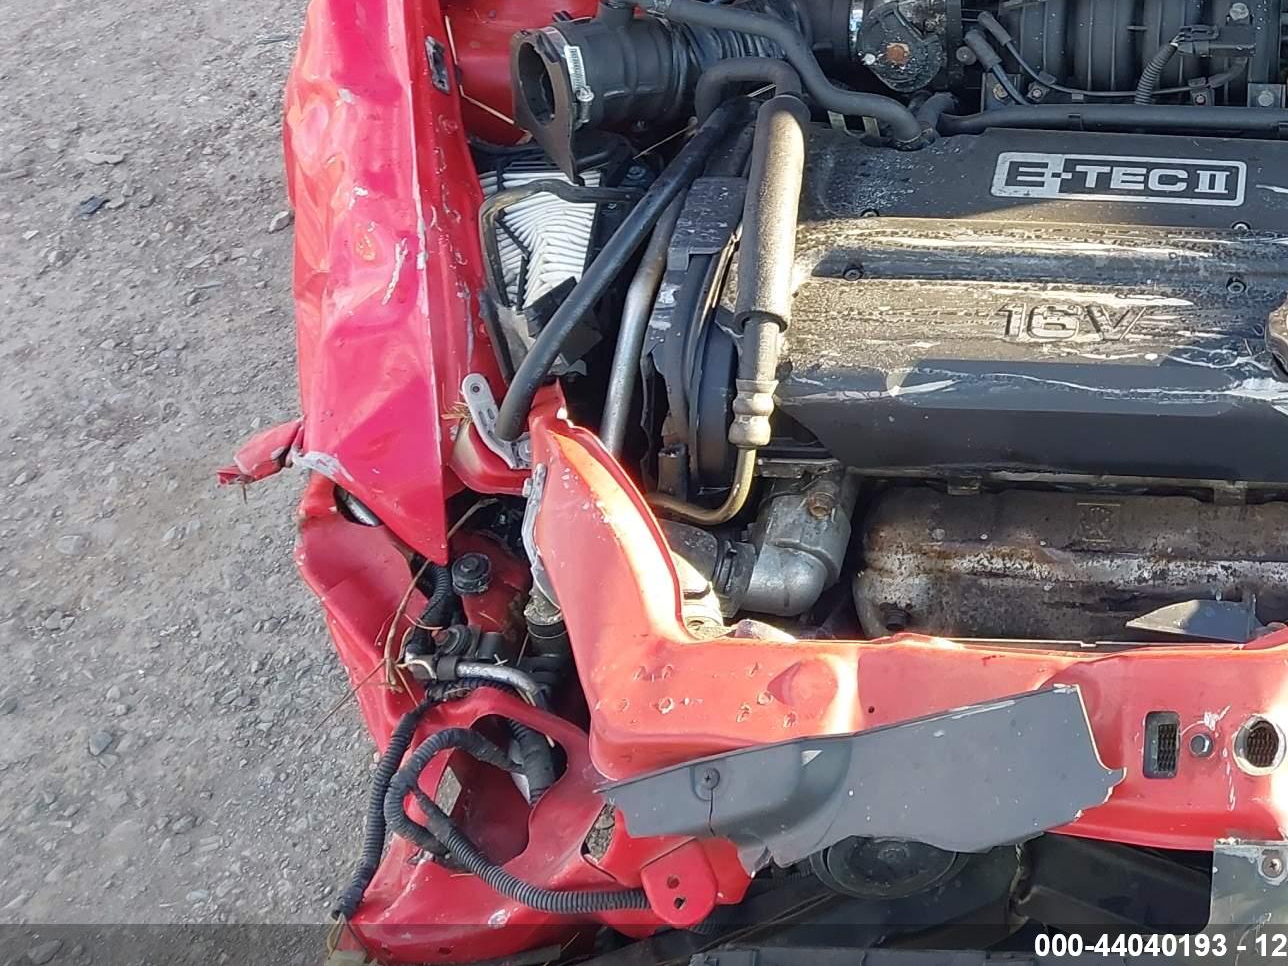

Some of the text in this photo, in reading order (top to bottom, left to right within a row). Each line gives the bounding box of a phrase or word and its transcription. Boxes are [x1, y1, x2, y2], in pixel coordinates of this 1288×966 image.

[1004, 160, 1231, 194] E-TEC II
[997, 302, 1147, 341] 16V
